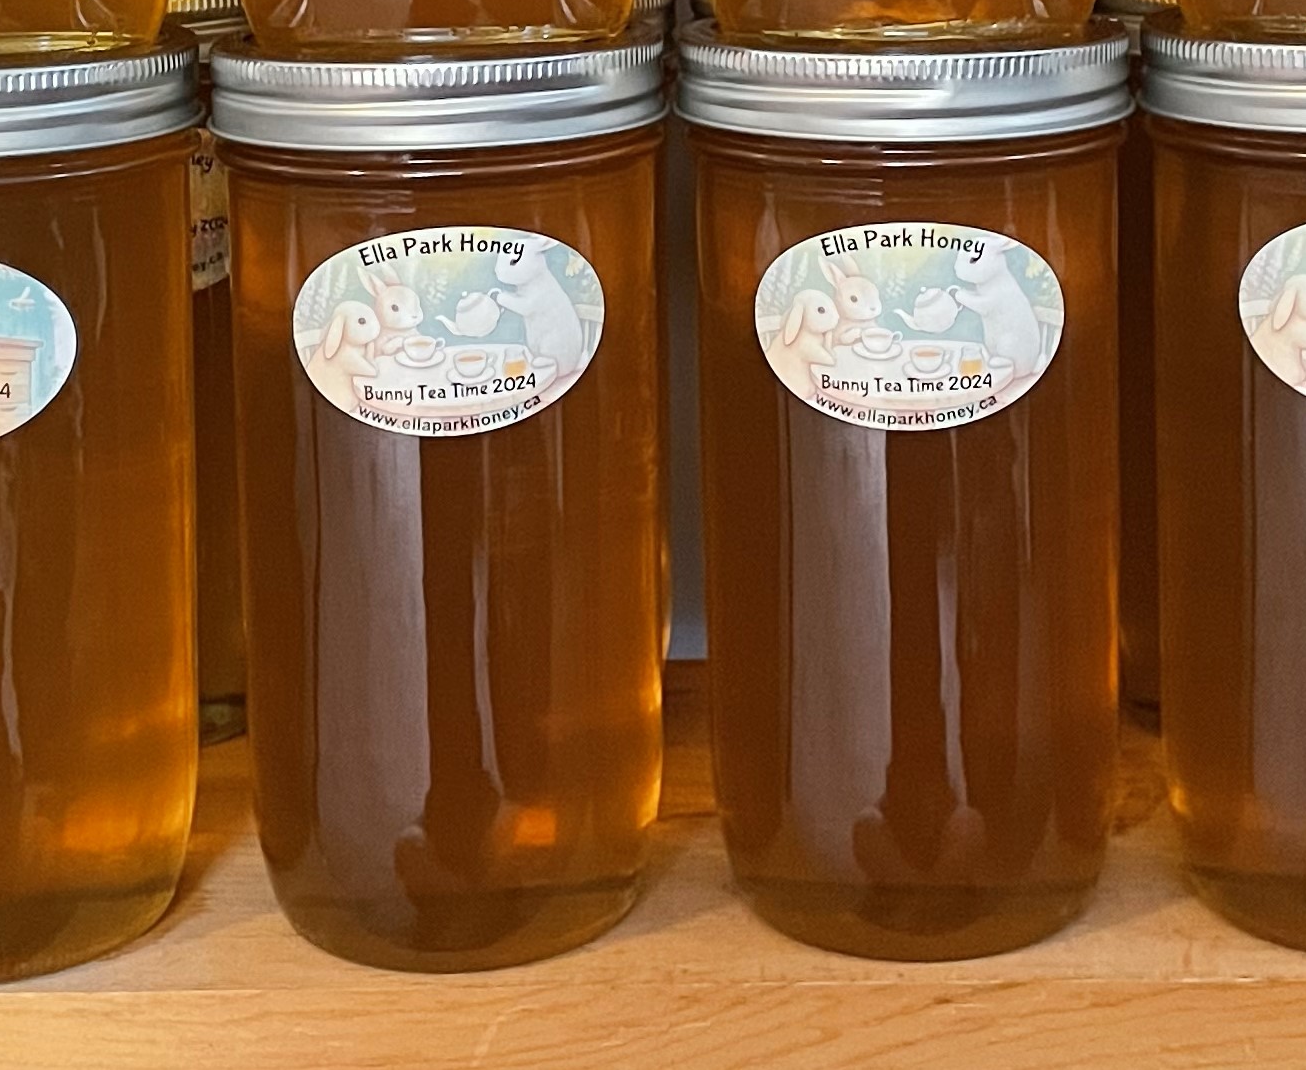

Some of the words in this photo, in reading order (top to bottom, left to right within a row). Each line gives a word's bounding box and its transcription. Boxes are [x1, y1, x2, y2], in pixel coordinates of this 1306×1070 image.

[358, 242, 397, 267] Ella
[402, 234, 453, 257] Park
[460, 234, 524, 268] Honey
[820, 236, 858, 257] Ella
[864, 229, 912, 250] Park
[921, 229, 985, 261] Honey
[364, 385, 413, 406] Bunny
[418, 385, 446, 400] Tea
[451, 383, 488, 398] Time
[493, 374, 536, 394] 2024
[821, 375, 869, 397] Bunny
[874, 378, 901, 392] Tea
[908, 378, 944, 392] Time
[949, 373, 992, 390] 2024
[358, 394, 541, 435] www.ellaparkhoney.ca
[816, 393, 997, 427] www.ellaparkhoney.ca
